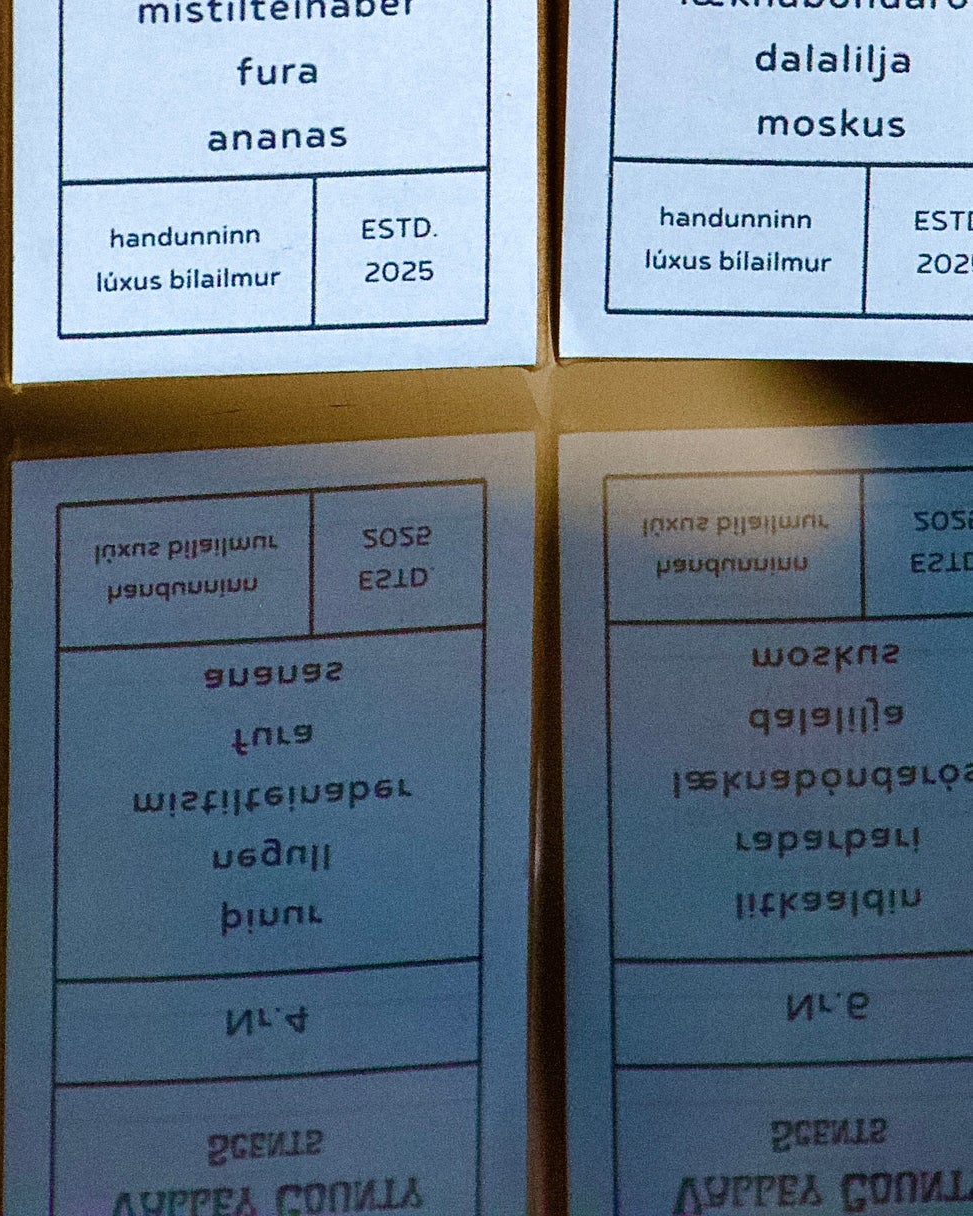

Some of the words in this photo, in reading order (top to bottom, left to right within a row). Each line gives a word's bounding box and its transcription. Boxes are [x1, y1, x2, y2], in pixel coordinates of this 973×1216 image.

[236, 56, 318, 86] fura
[755, 42, 911, 83] dalalilja
[757, 108, 906, 138] moskus
[207, 126, 347, 152] ananas
[361, 215, 439, 240] ESTD.
[660, 206, 812, 229] handunninn
[110, 226, 261, 249] handunninn
[364, 259, 435, 283] 2025
[645, 248, 712, 271] lúxus
[719, 250, 832, 273] bílailmur
[916, 252, 973, 275] 202
[96, 271, 163, 293] lúxus
